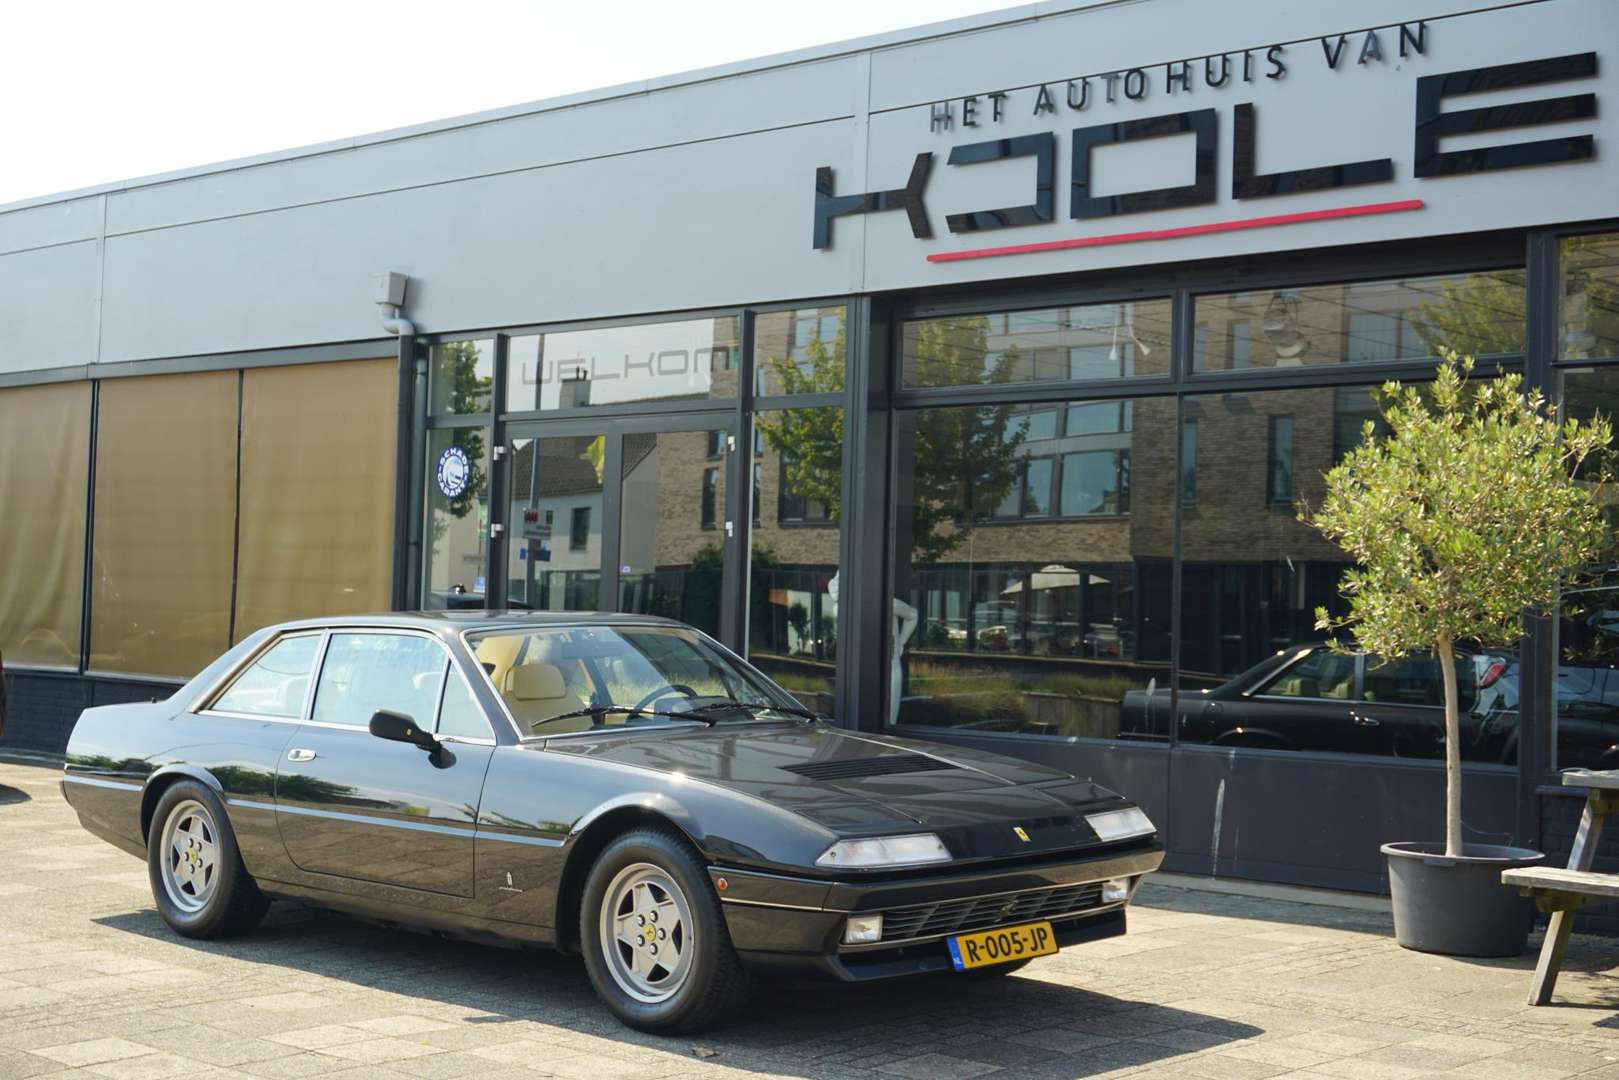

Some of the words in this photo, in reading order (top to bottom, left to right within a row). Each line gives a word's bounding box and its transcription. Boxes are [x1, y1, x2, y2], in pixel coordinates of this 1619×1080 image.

[930, 92, 1009, 132] HET
[1033, 45, 1285, 116] AUTOHUIS
[1321, 21, 1426, 70] VAN
[814, 52, 1597, 250] KOOLE
[522, 347, 730, 385] WELKOM
[440, 447, 469, 474] SCHADE
[437, 473, 466, 497] GARANT
[965, 927, 1048, 963] R-005-JP
